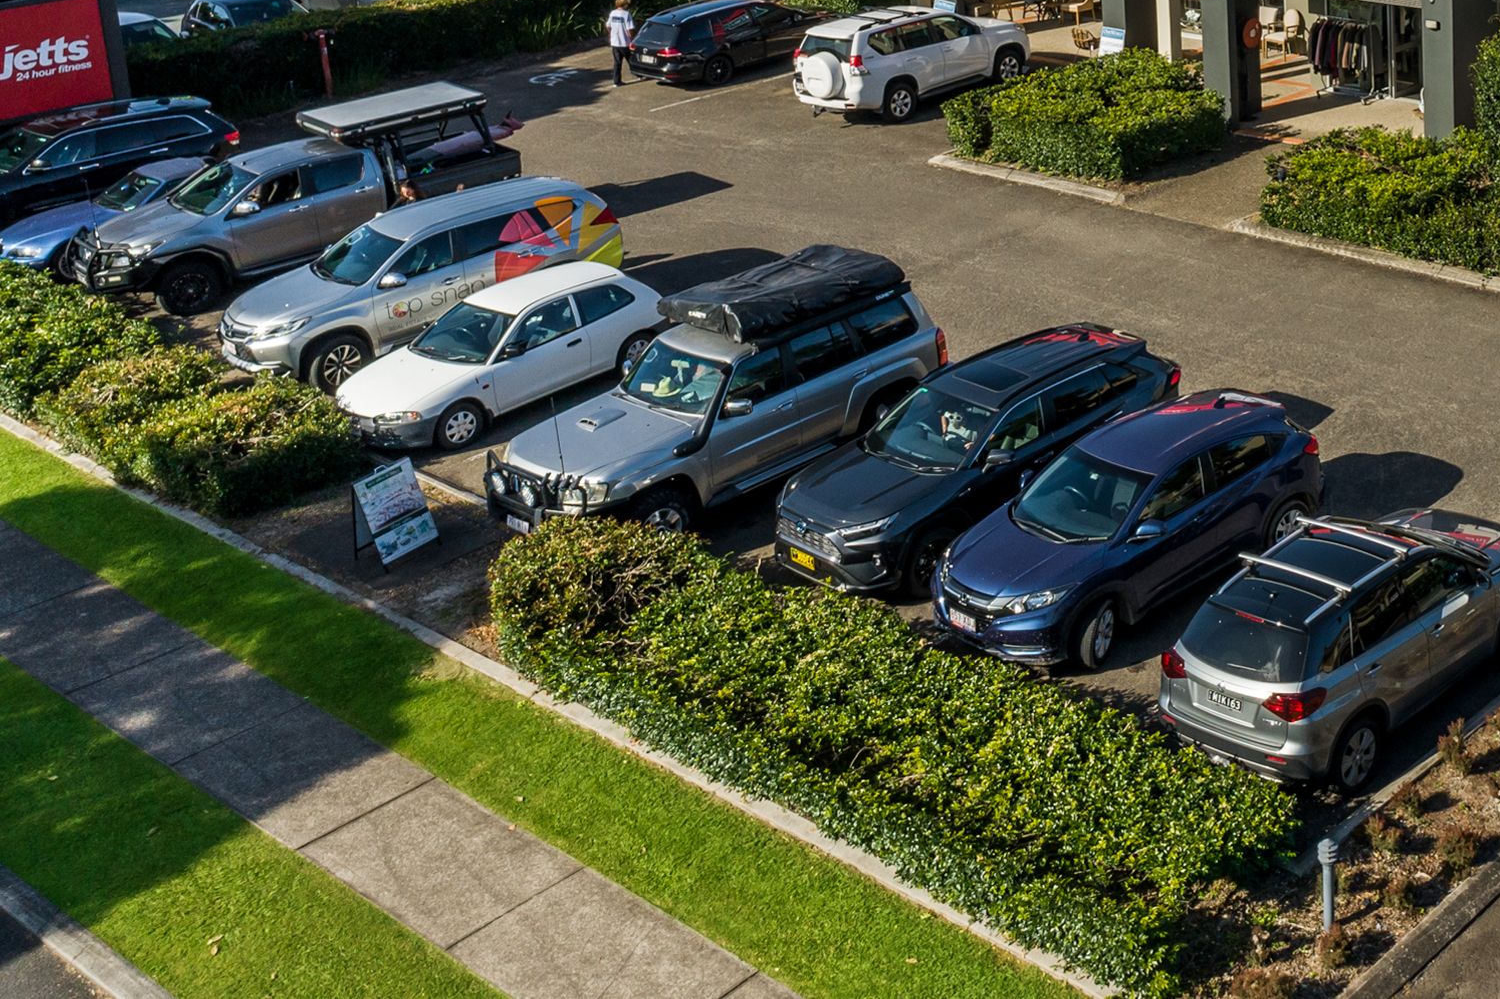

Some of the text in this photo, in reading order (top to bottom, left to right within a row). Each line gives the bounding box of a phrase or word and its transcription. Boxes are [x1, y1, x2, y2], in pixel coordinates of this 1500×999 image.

[0, 35, 90, 81] jetts
[16, 60, 92, 82] 24 hour fitness
[385, 297, 423, 320] top
